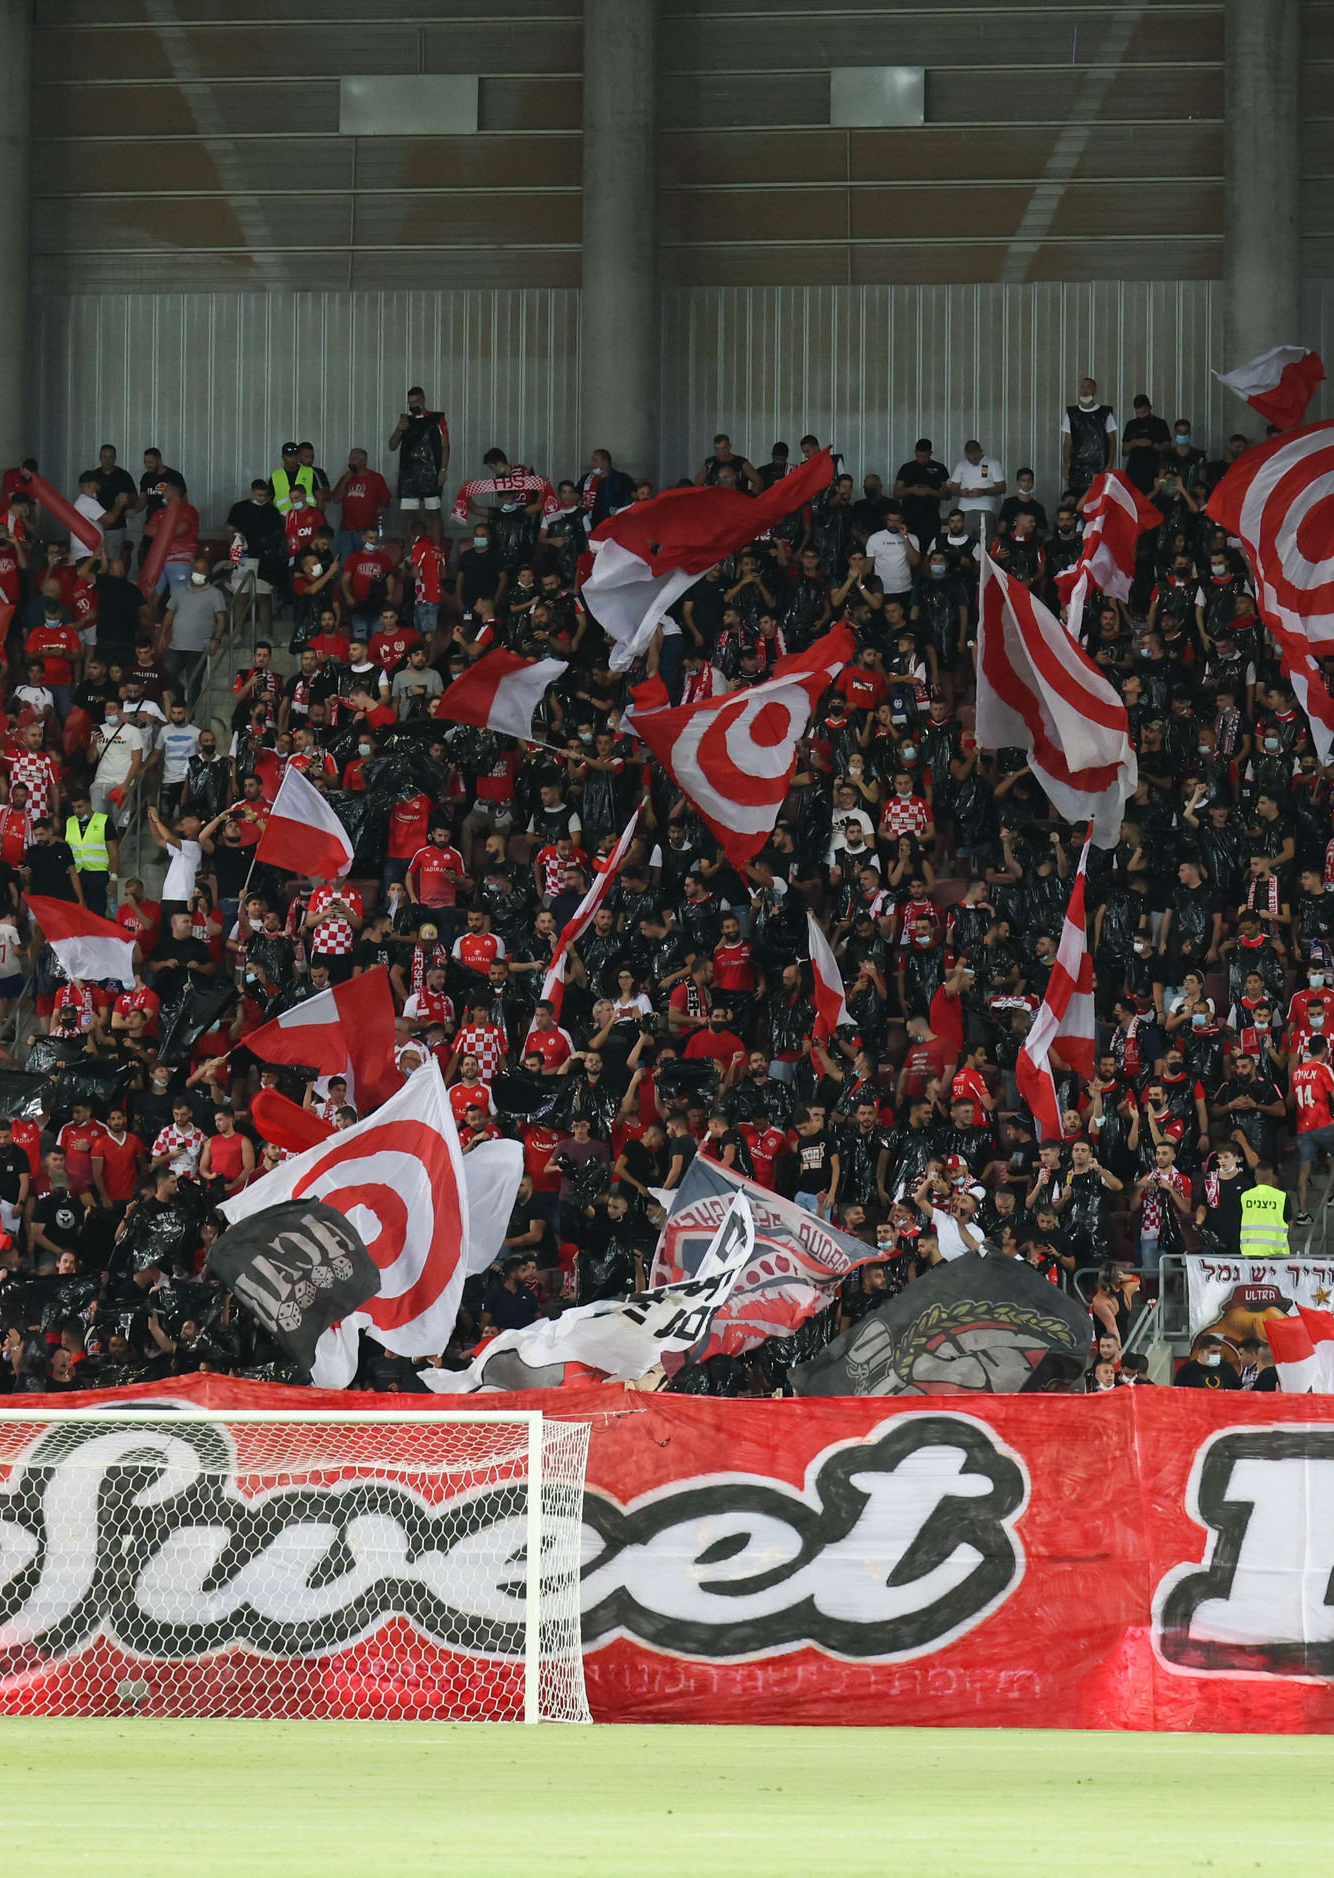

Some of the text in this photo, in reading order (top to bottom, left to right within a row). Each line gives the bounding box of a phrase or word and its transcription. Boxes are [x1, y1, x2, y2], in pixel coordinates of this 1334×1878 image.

[1295, 1084, 1316, 1109] 14
[1245, 1199, 1278, 1211] ניצנים
[1250, 1266, 1277, 1284] יש
[1244, 1289, 1276, 1301] ULTRA
